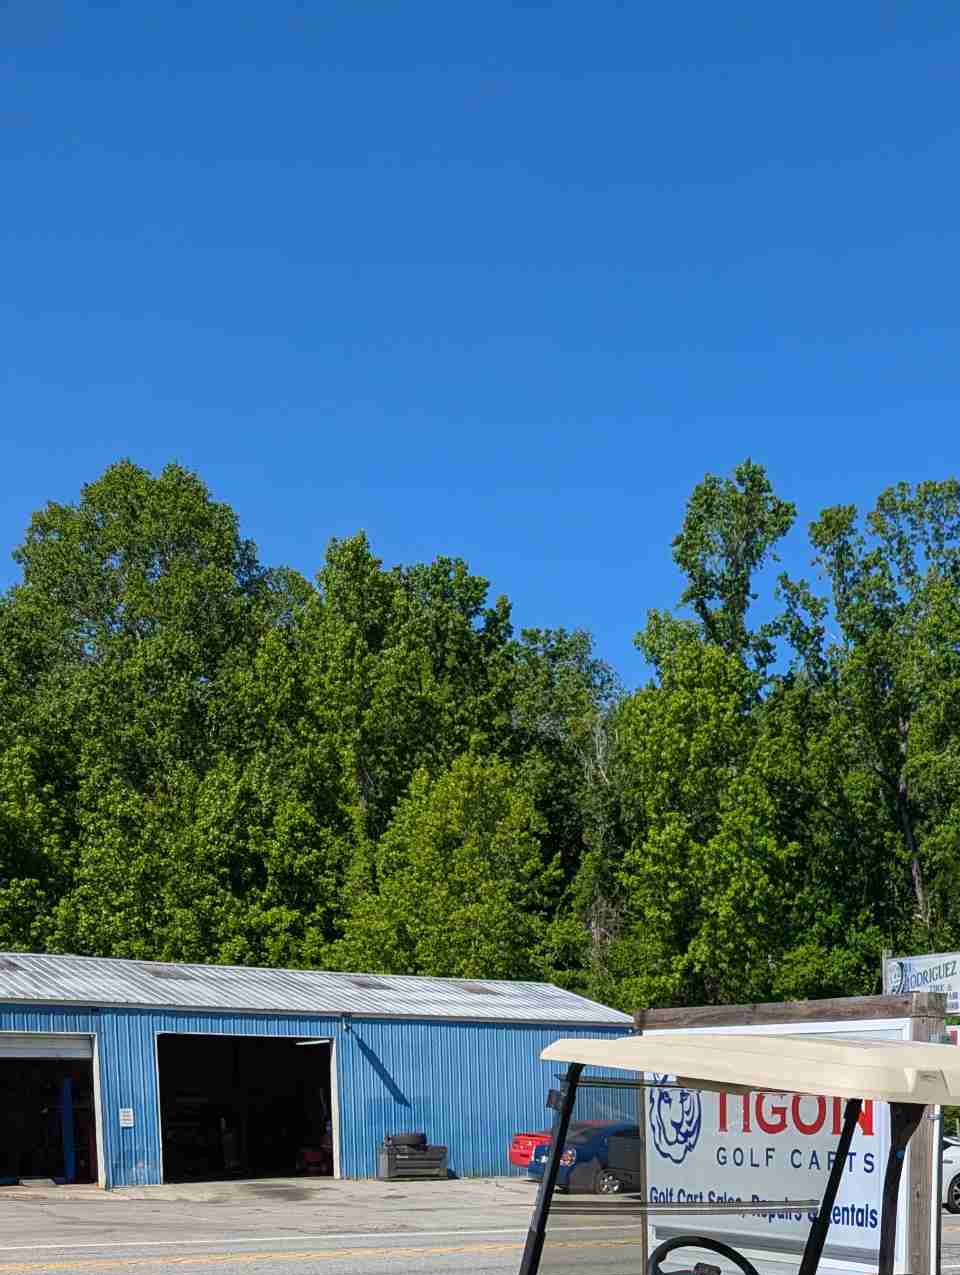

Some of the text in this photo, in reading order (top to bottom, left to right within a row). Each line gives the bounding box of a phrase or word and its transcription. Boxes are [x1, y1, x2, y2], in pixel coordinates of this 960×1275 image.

[716, 1146, 775, 1168] GOLF
[650, 1186, 673, 1205] Golf
[829, 1200, 878, 1229] entals
